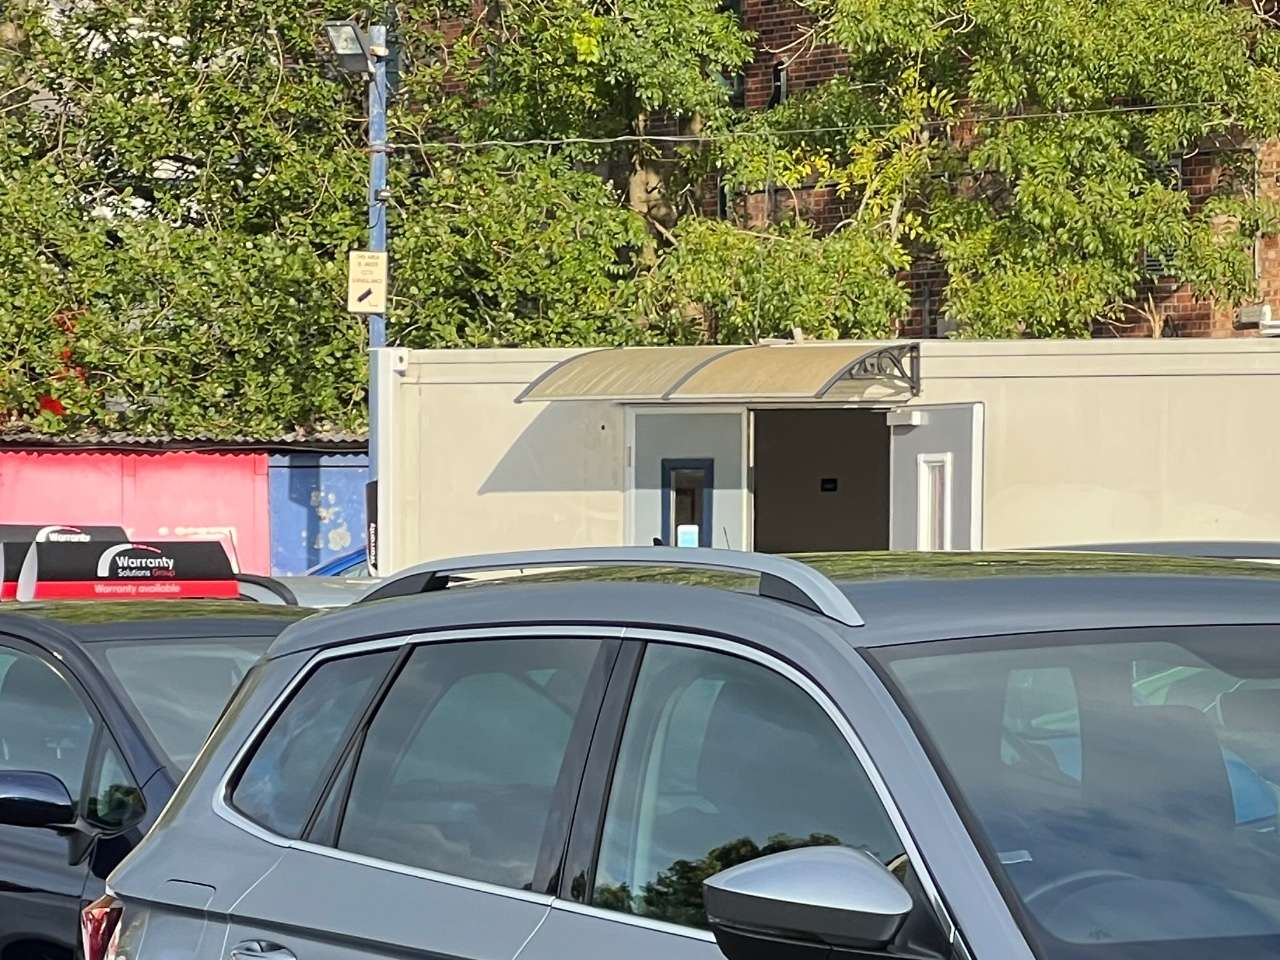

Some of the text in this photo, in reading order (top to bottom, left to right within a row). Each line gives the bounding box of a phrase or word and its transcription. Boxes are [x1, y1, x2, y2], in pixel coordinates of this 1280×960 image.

[115, 556, 175, 570] Warranty
[117, 568, 176, 577] Solutions Group
[94, 583, 181, 595] Warranty available
